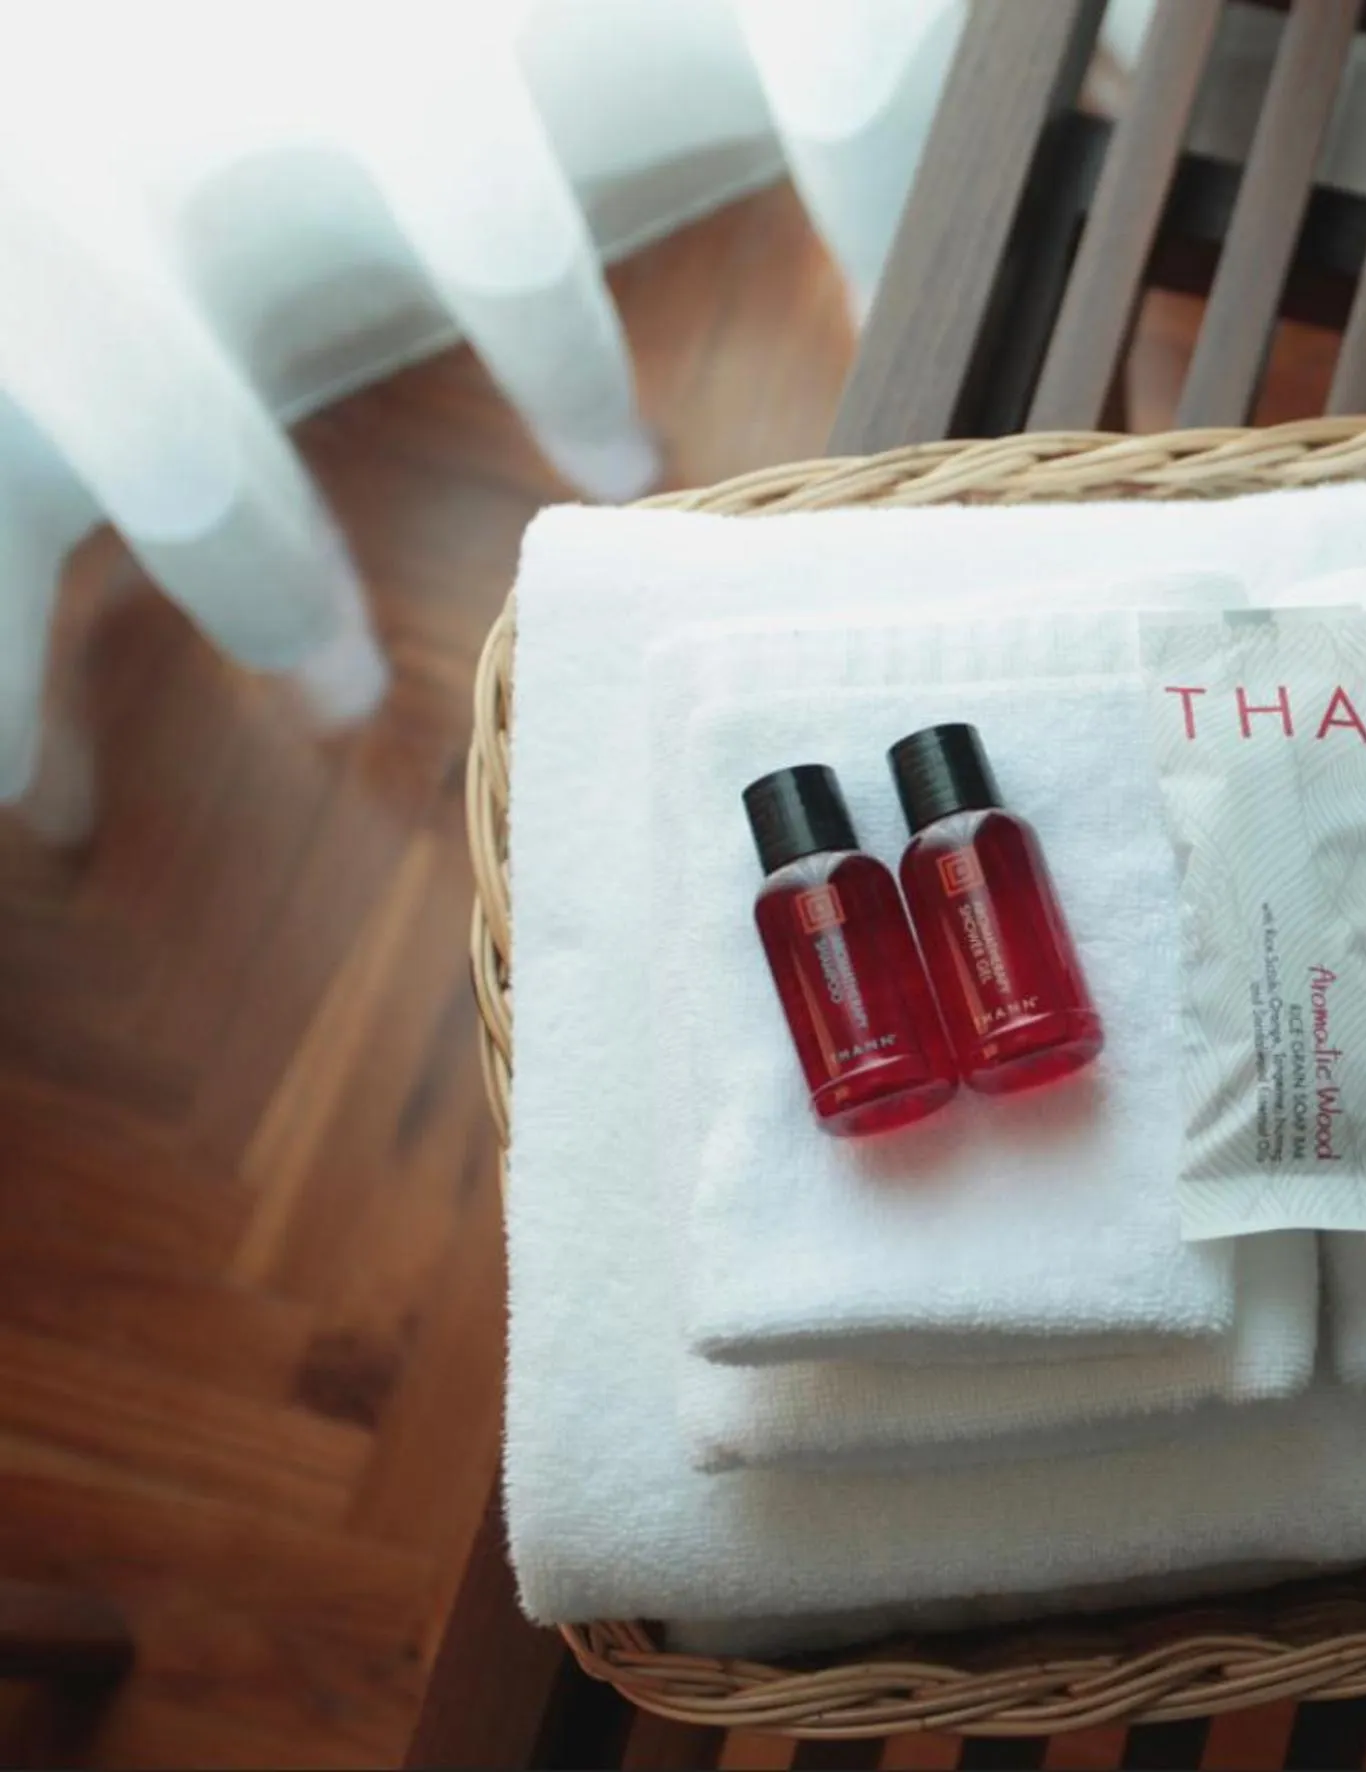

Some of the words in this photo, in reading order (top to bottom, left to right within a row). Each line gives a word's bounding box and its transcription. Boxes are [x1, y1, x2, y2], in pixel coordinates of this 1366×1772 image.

[959, 903, 985, 958] SHOWER
[976, 957, 994, 985] GEL
[1288, 1003, 1303, 1034] RICE
[1307, 963, 1343, 1080] Aromatic
[1291, 1040, 1306, 1088] GRAIN
[1293, 1093, 1308, 1131] SOAP
[1315, 1087, 1344, 1160] Wood
[1293, 1135, 1305, 1159] BAR
